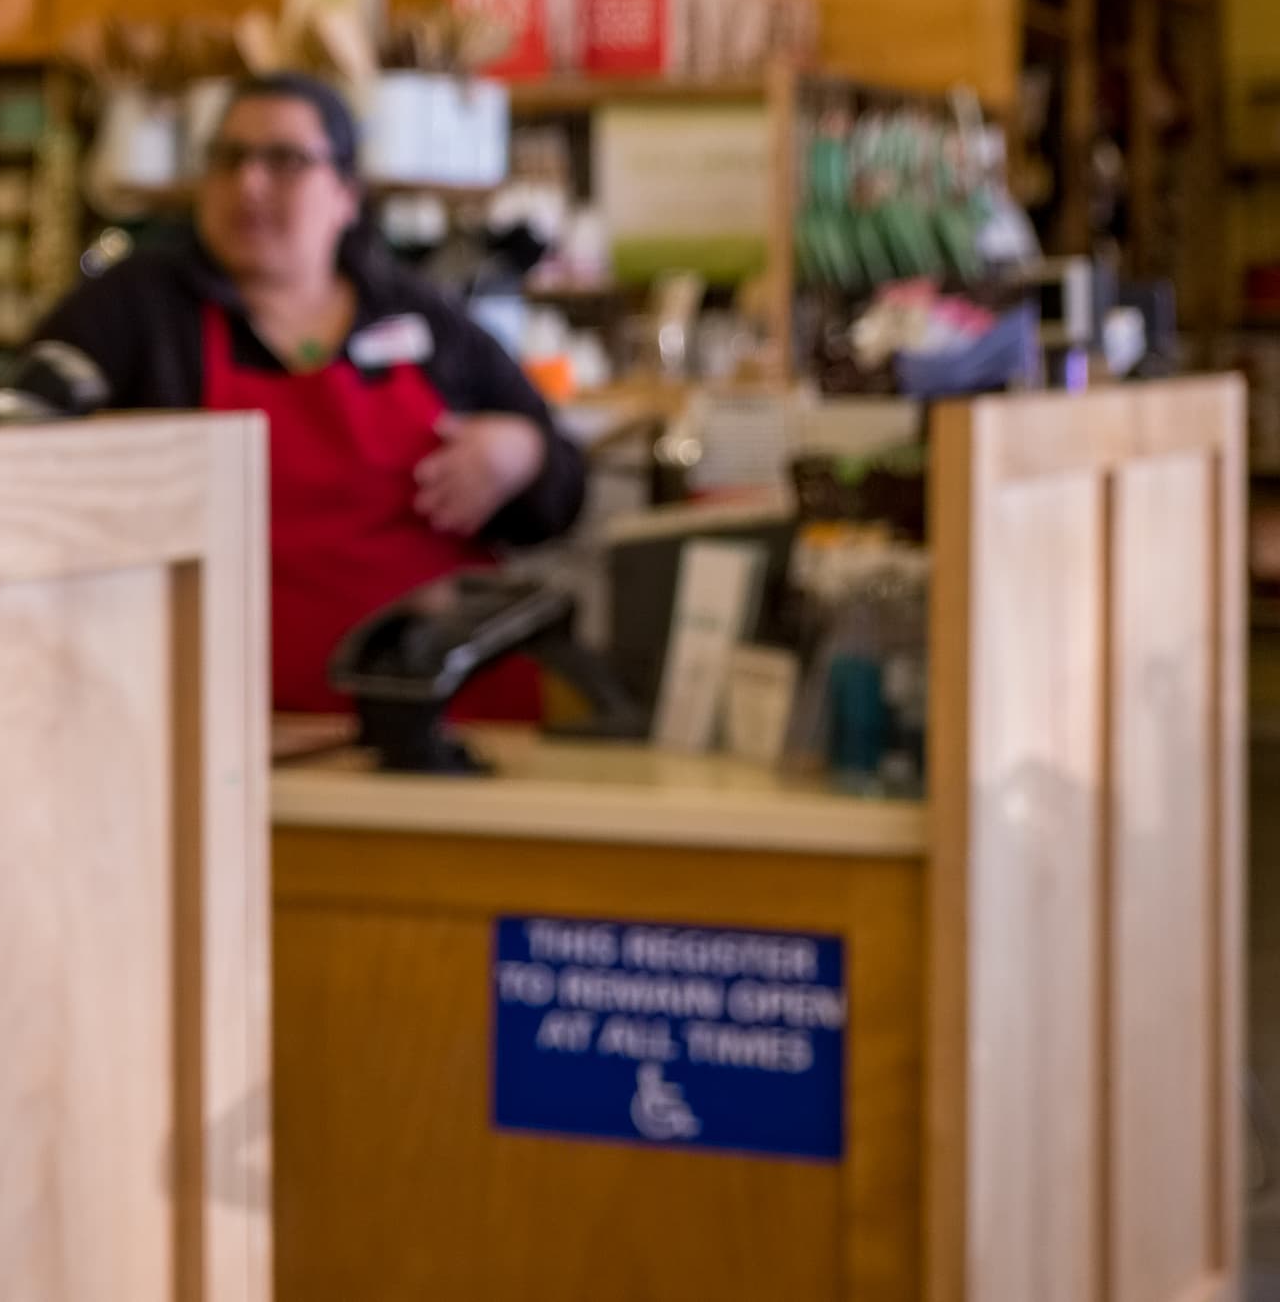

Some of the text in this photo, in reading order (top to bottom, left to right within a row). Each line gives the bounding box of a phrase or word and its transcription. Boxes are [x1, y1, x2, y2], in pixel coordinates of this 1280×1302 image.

[527, 920, 817, 979] THIS REGISTER
[500, 960, 555, 1005] TO
[728, 979, 847, 1029] OPEN
[536, 1009, 814, 1072] AT ALL TIMES
